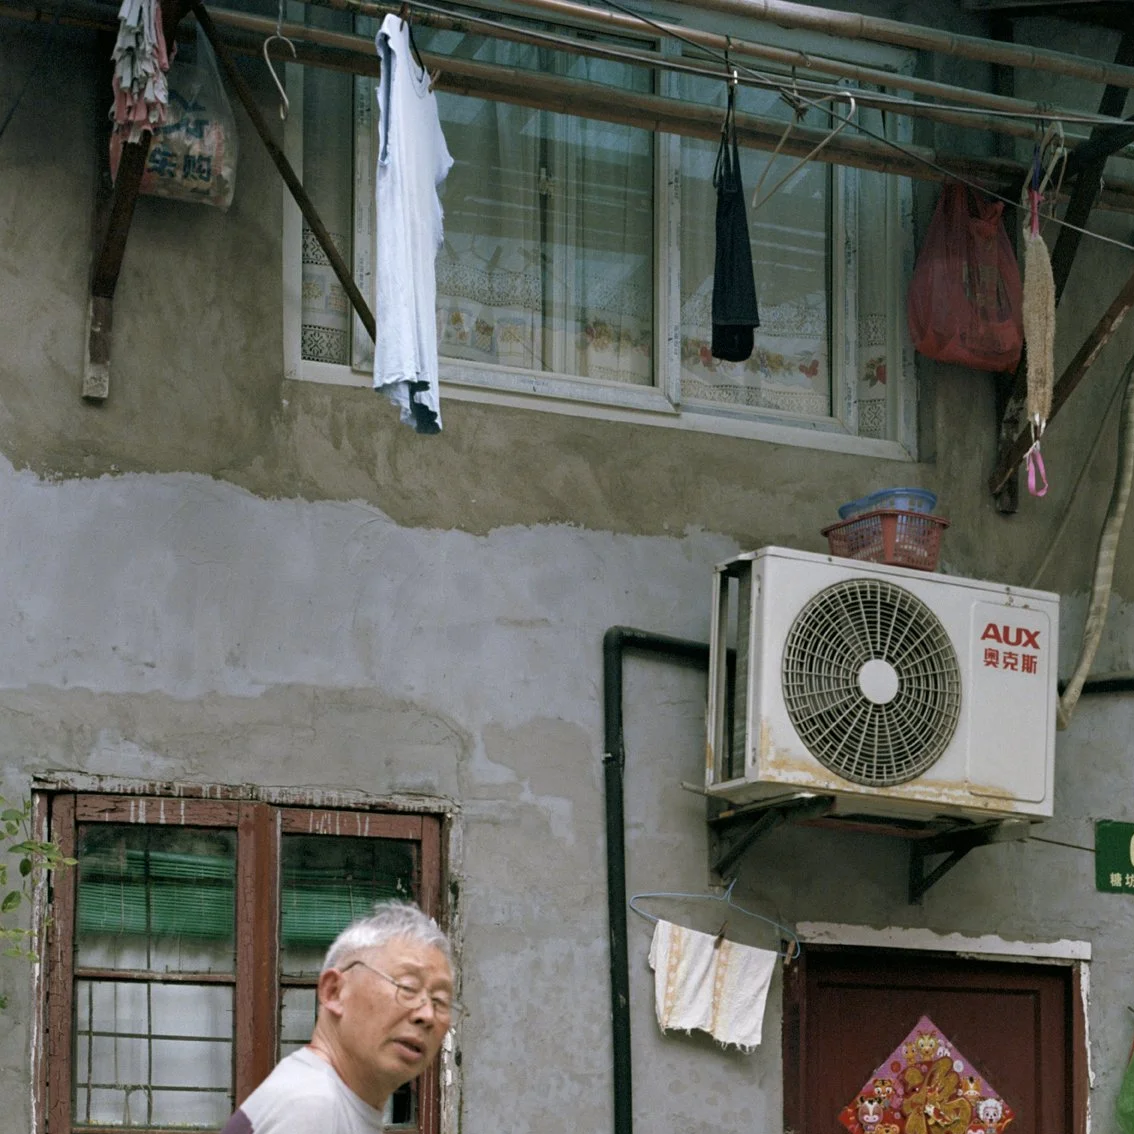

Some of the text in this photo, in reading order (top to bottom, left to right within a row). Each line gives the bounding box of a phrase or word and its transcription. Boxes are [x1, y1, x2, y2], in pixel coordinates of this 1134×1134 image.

[980, 623, 1041, 650] AUX
[983, 648, 1038, 675] 奥克斯
